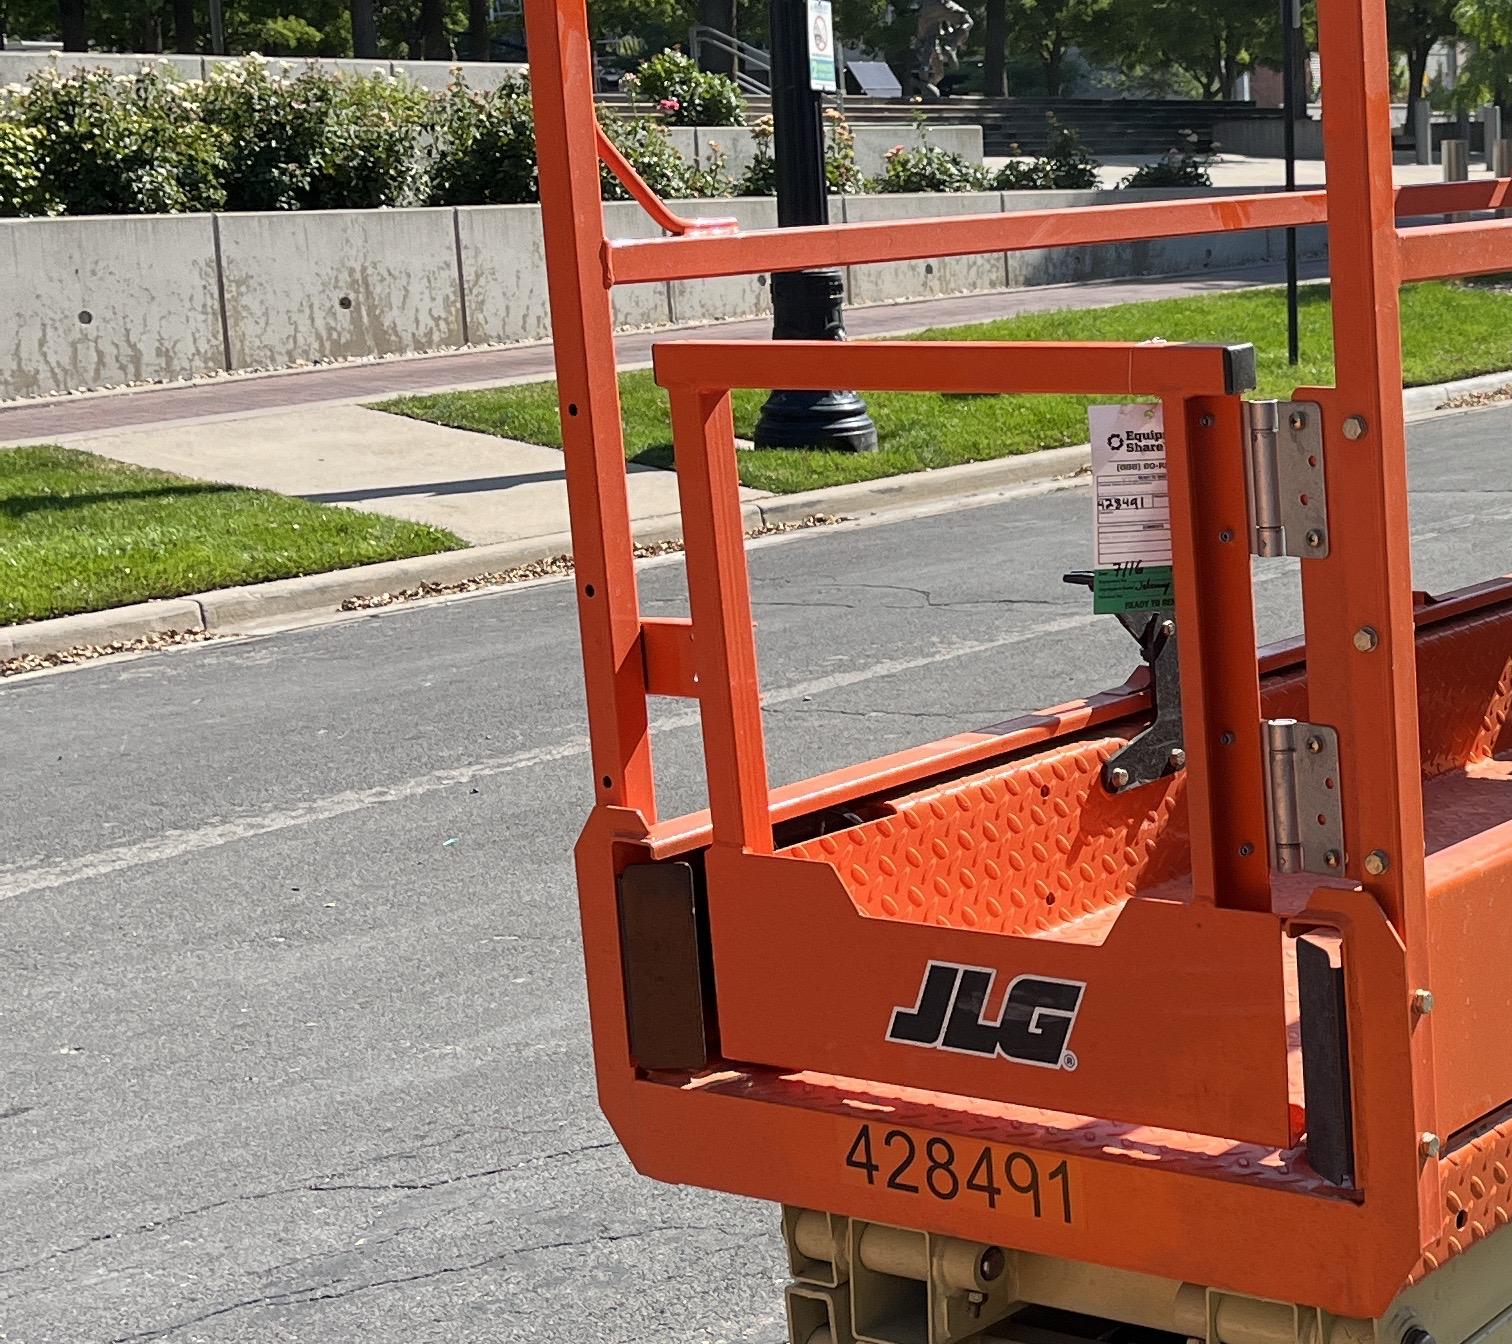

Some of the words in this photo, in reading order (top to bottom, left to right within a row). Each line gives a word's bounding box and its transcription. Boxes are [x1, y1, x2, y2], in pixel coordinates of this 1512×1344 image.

[1126, 442, 1164, 453] Share
[1098, 497, 1144, 511] 428491
[885, 960, 1087, 1070] JLG
[846, 1124, 1072, 1224] 428491
